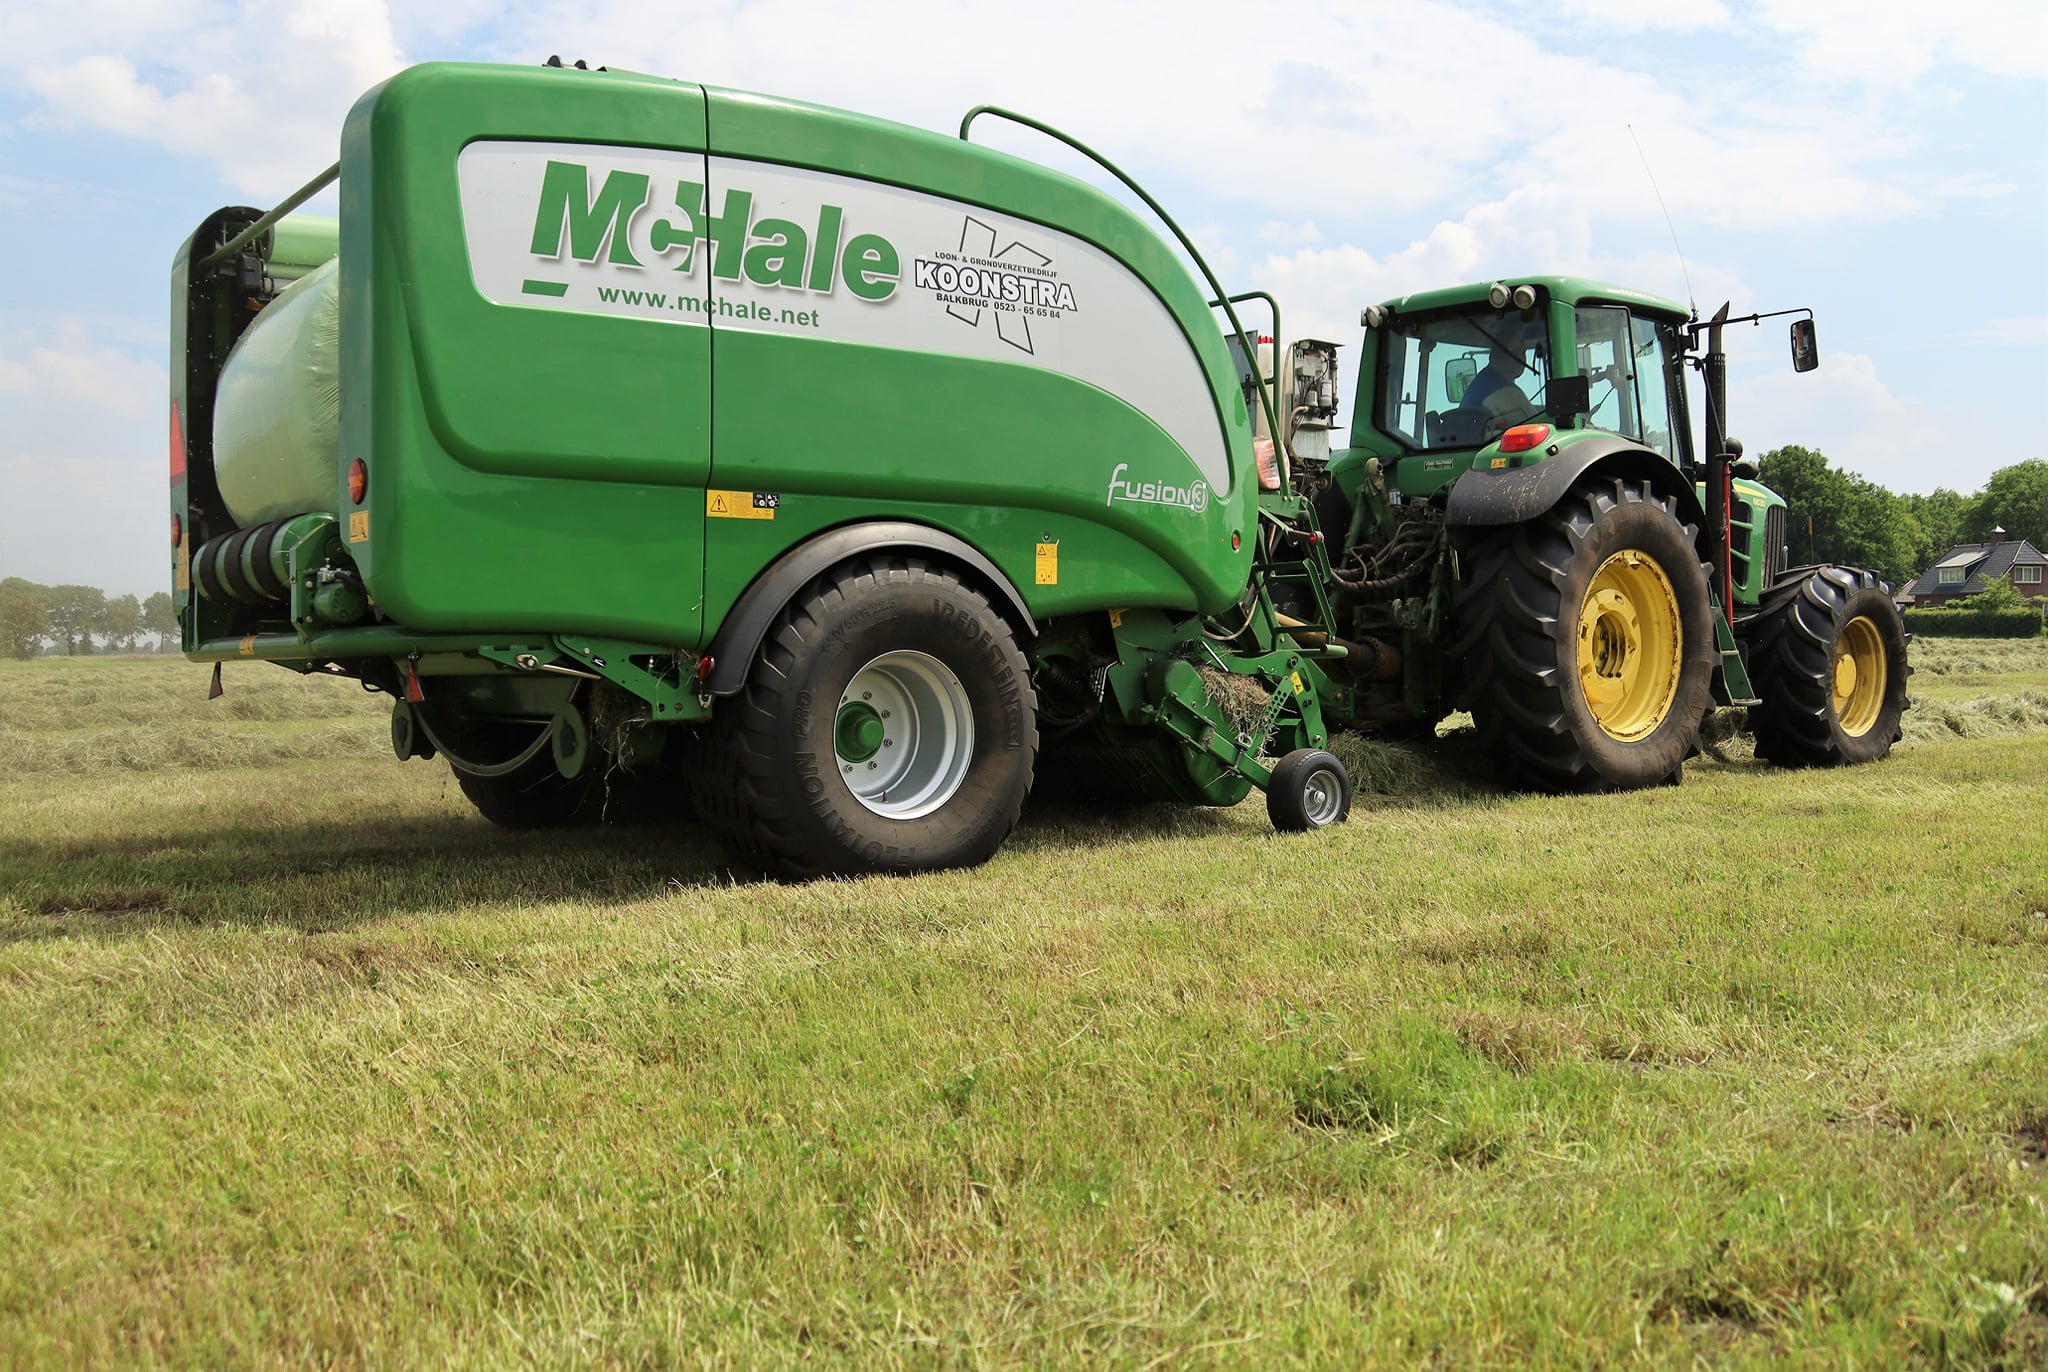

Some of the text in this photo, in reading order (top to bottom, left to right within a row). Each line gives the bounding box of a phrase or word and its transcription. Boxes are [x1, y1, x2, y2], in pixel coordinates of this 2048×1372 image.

[529, 159, 901, 302] McHale
[915, 259, 1078, 312] KOONSTRA
[935, 251, 960, 263] LOON-
[970, 257, 1058, 279] GRONDVERZETBEDRIJF
[598, 286, 820, 328] www.mchale.net
[936, 292, 989, 308] BALKBRUG
[993, 301, 1016, 312] 0523
[1023, 305, 1034, 315] 65
[1037, 308, 1047, 318] 65
[1049, 309, 1061, 319] 84
